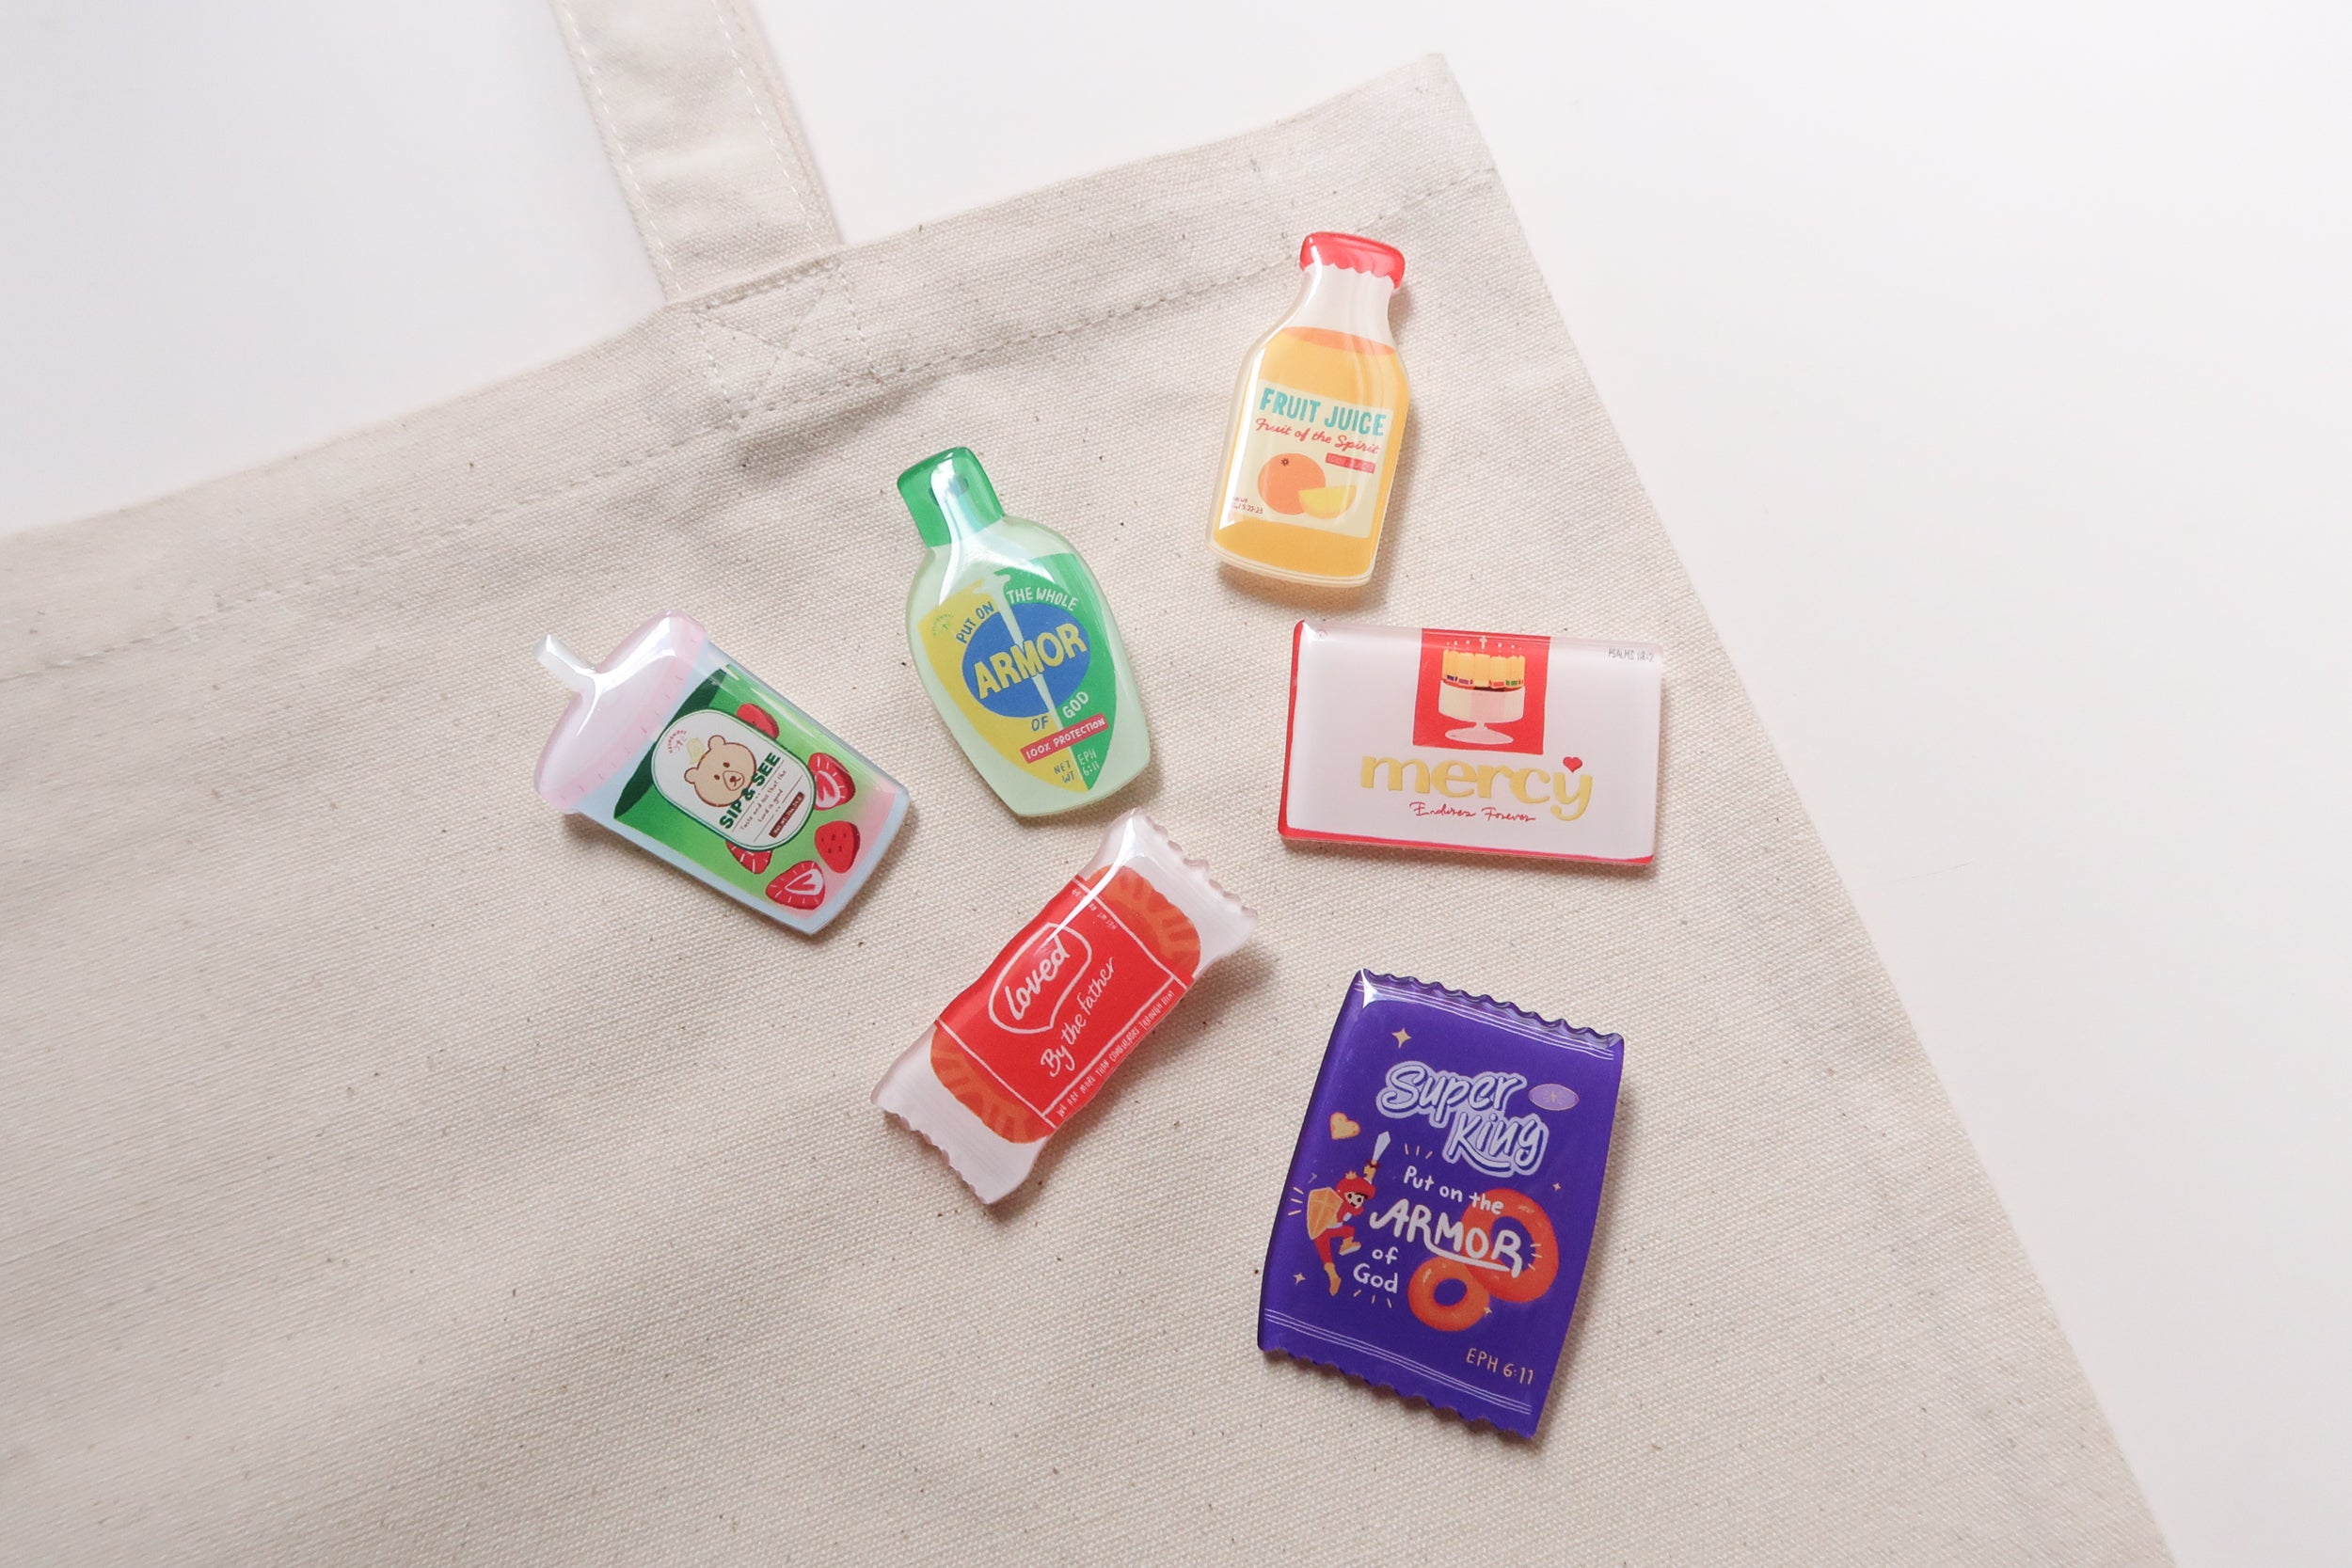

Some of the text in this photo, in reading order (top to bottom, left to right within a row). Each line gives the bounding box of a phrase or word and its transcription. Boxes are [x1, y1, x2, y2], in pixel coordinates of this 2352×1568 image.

[1259, 388, 1387, 436] FRUIT JUICE
[1255, 418, 1380, 454] Fruit of the Spirit
[1006, 587, 1078, 611] THE WHOLE
[956, 617, 977, 643] PUT
[977, 601, 995, 620] ON
[973, 623, 1088, 700] ARMOR
[1031, 691, 1089, 732] OF GOD
[1025, 718, 1106, 760] 100% PROTECTION
[1078, 749, 1097, 766] EPH
[1054, 760, 1071, 774] NET
[1062, 772, 1075, 784] WT
[1083, 762, 1100, 775] 6:11
[719, 752, 781, 830] SIP & SEE
[1360, 755, 1593, 822] mercy
[1409, 801, 1535, 822] Endures Forever
[1040, 957, 1115, 1077] By the father
[1377, 1063, 1524, 1126] Super
[1444, 1113, 1548, 1177] King
[1403, 1165, 1503, 1215] Put on the
[1370, 1198, 1522, 1277] ARMOR
[1372, 1246, 1399, 1264] of
[1353, 1262, 1398, 1293] God
[1467, 1348, 1535, 1385] EPH 6:11
